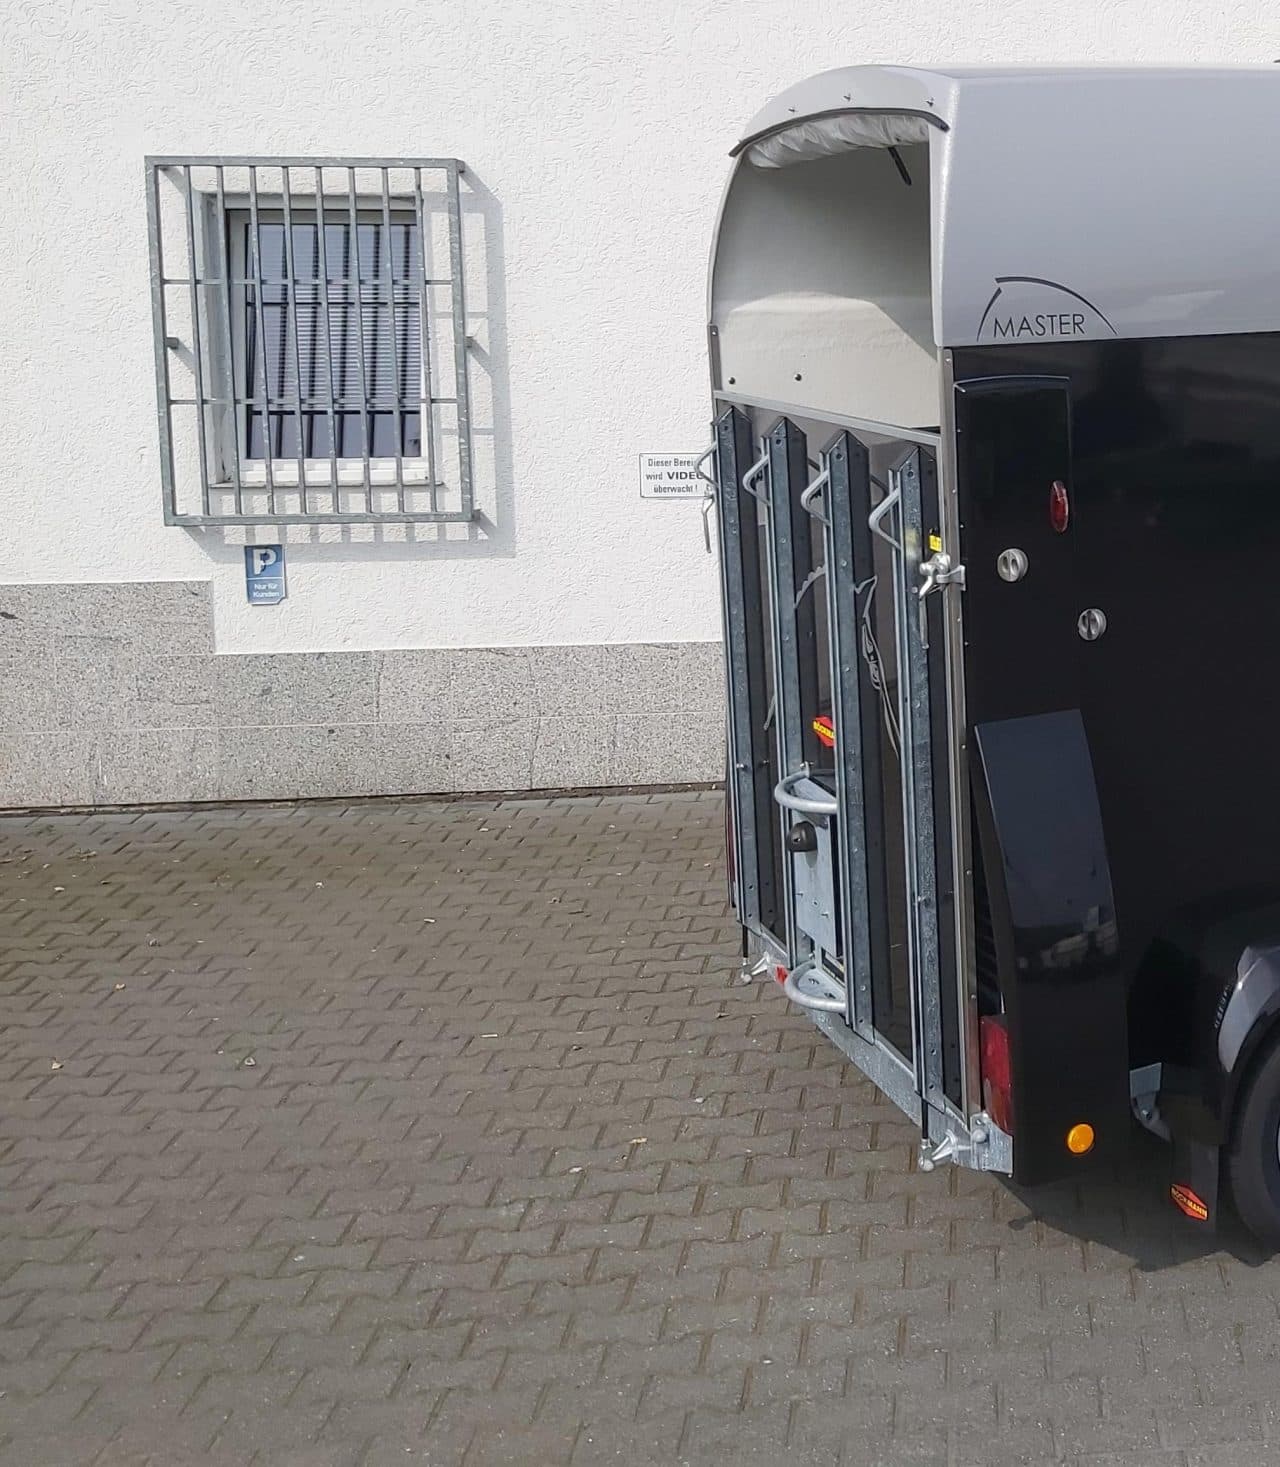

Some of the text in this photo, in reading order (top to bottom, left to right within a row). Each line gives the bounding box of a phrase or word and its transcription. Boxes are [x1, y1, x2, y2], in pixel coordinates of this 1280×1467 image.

[993, 313, 1086, 338] MASTER
[648, 458, 703, 467] Dieser Berei
[645, 471, 663, 480] wird
[653, 484, 694, 493] überwacht
[253, 548, 277, 575] P
